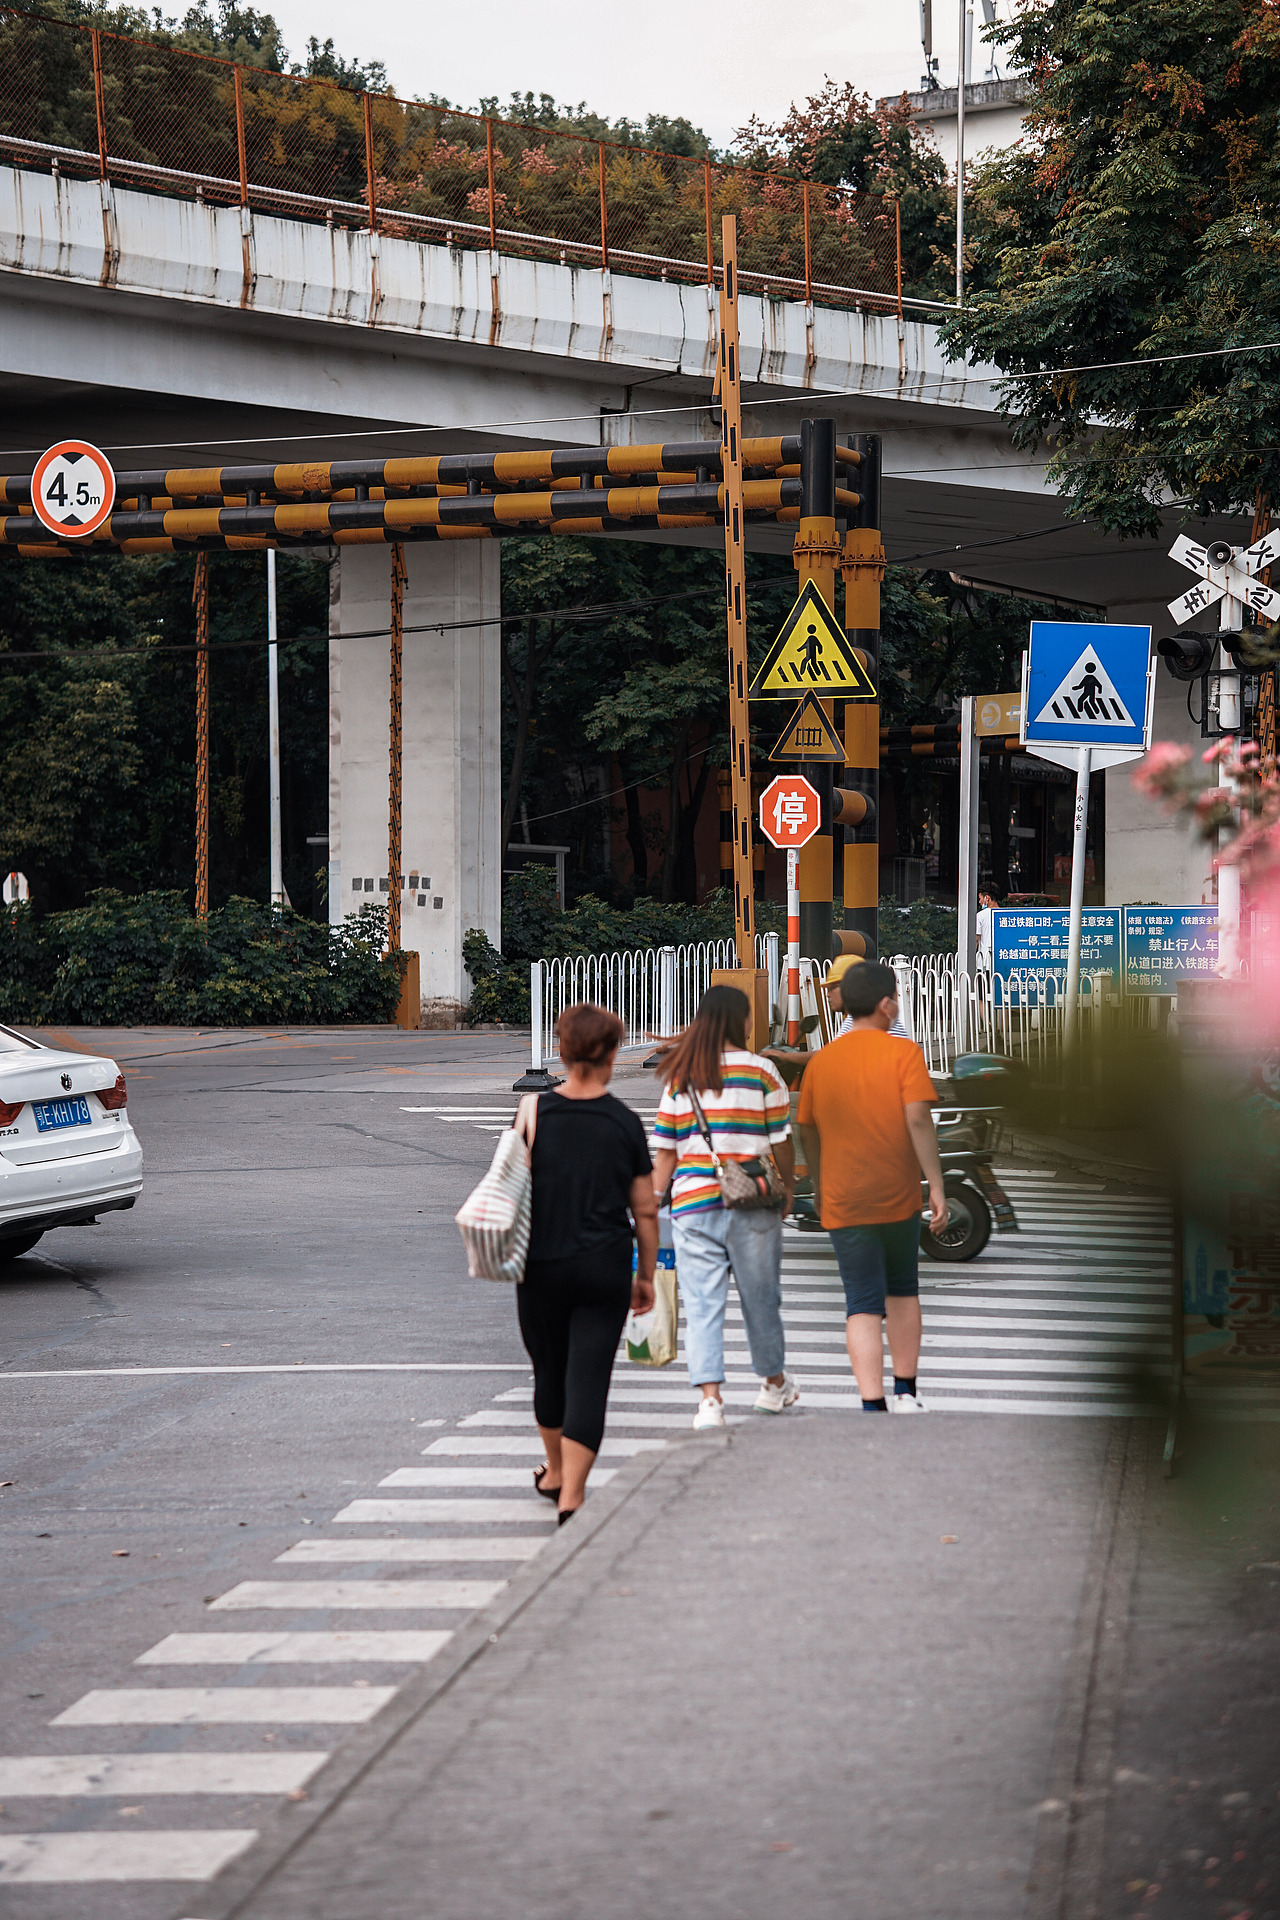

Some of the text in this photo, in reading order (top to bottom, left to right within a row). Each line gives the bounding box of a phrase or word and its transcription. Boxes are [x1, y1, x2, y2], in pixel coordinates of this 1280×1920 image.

[46, 471, 101, 507] 4.5m
[772, 791, 808, 835] 停
[1074, 794, 1085, 832] 小心火车
[998, 916, 1115, 928] 通过铁路口时,一定注意安全
[1018, 934, 1114, 946] 一停,二看,三过,不要
[998, 948, 1103, 960] 抢越道口,不要翻栏门.
